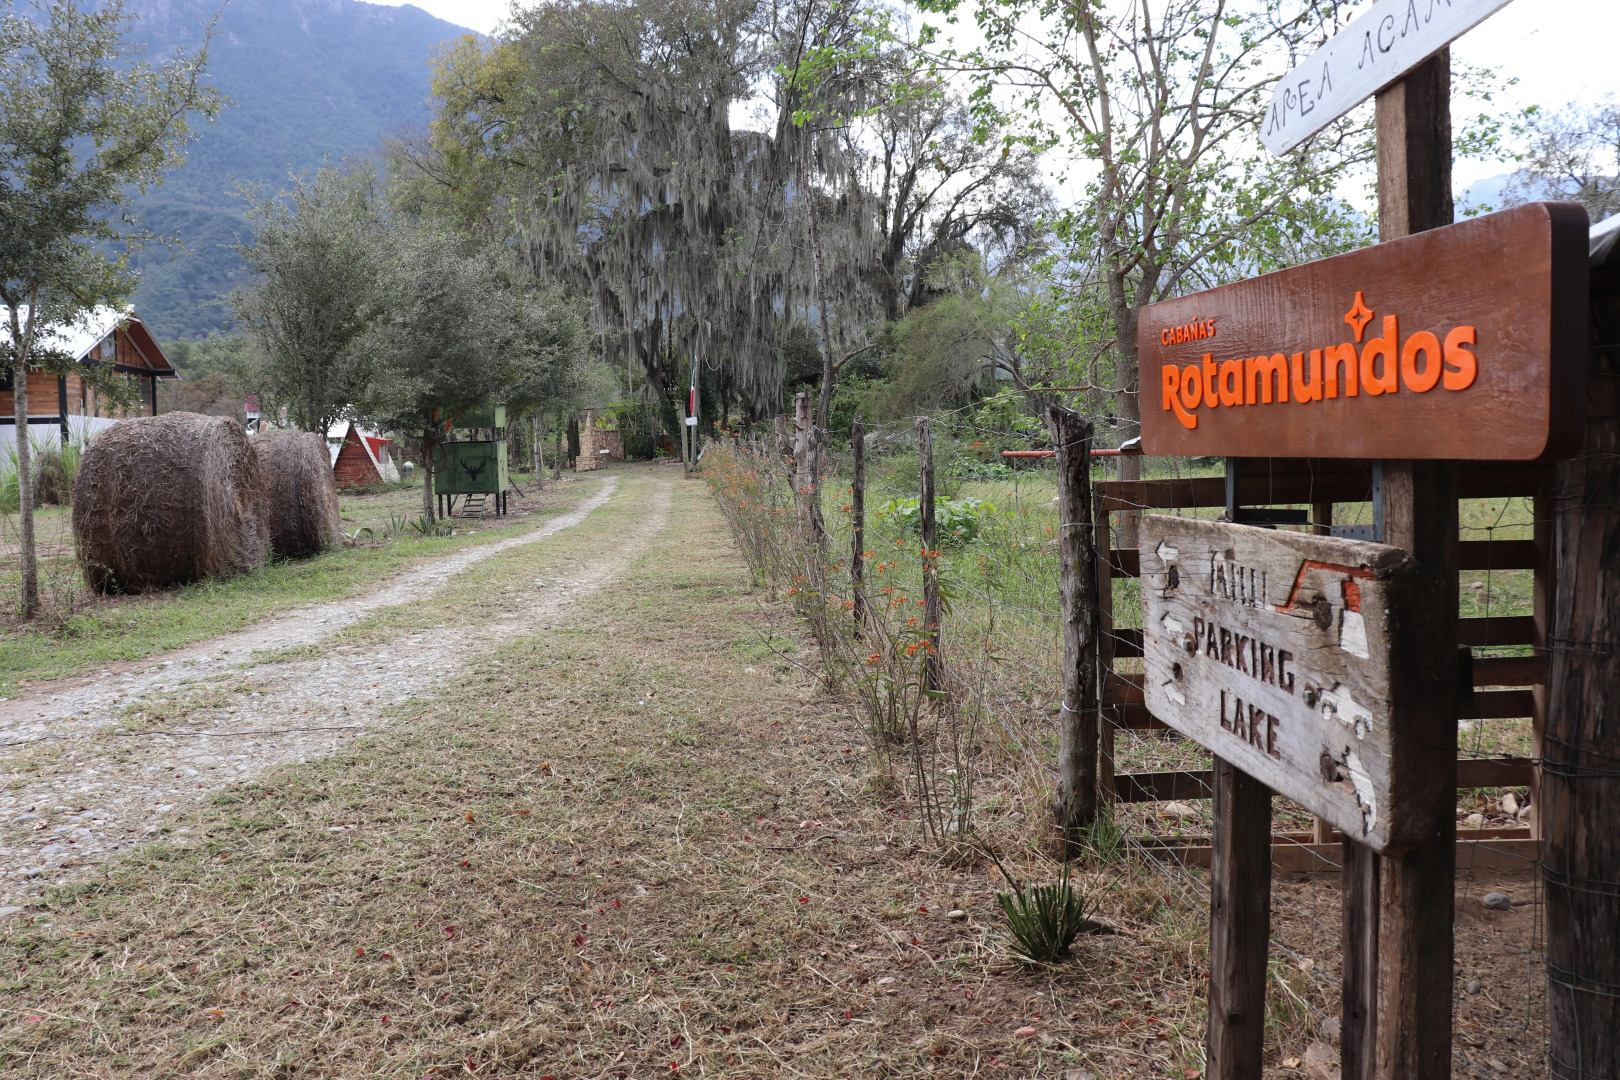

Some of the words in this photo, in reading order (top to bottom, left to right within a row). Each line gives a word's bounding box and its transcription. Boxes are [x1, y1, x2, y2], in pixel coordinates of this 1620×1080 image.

[1161, 317, 1216, 346] CABAÑAS
[1161, 314, 1477, 429] Rotamundos
[1194, 616, 1295, 696] PARKING
[1220, 689, 1281, 760] LAKE
